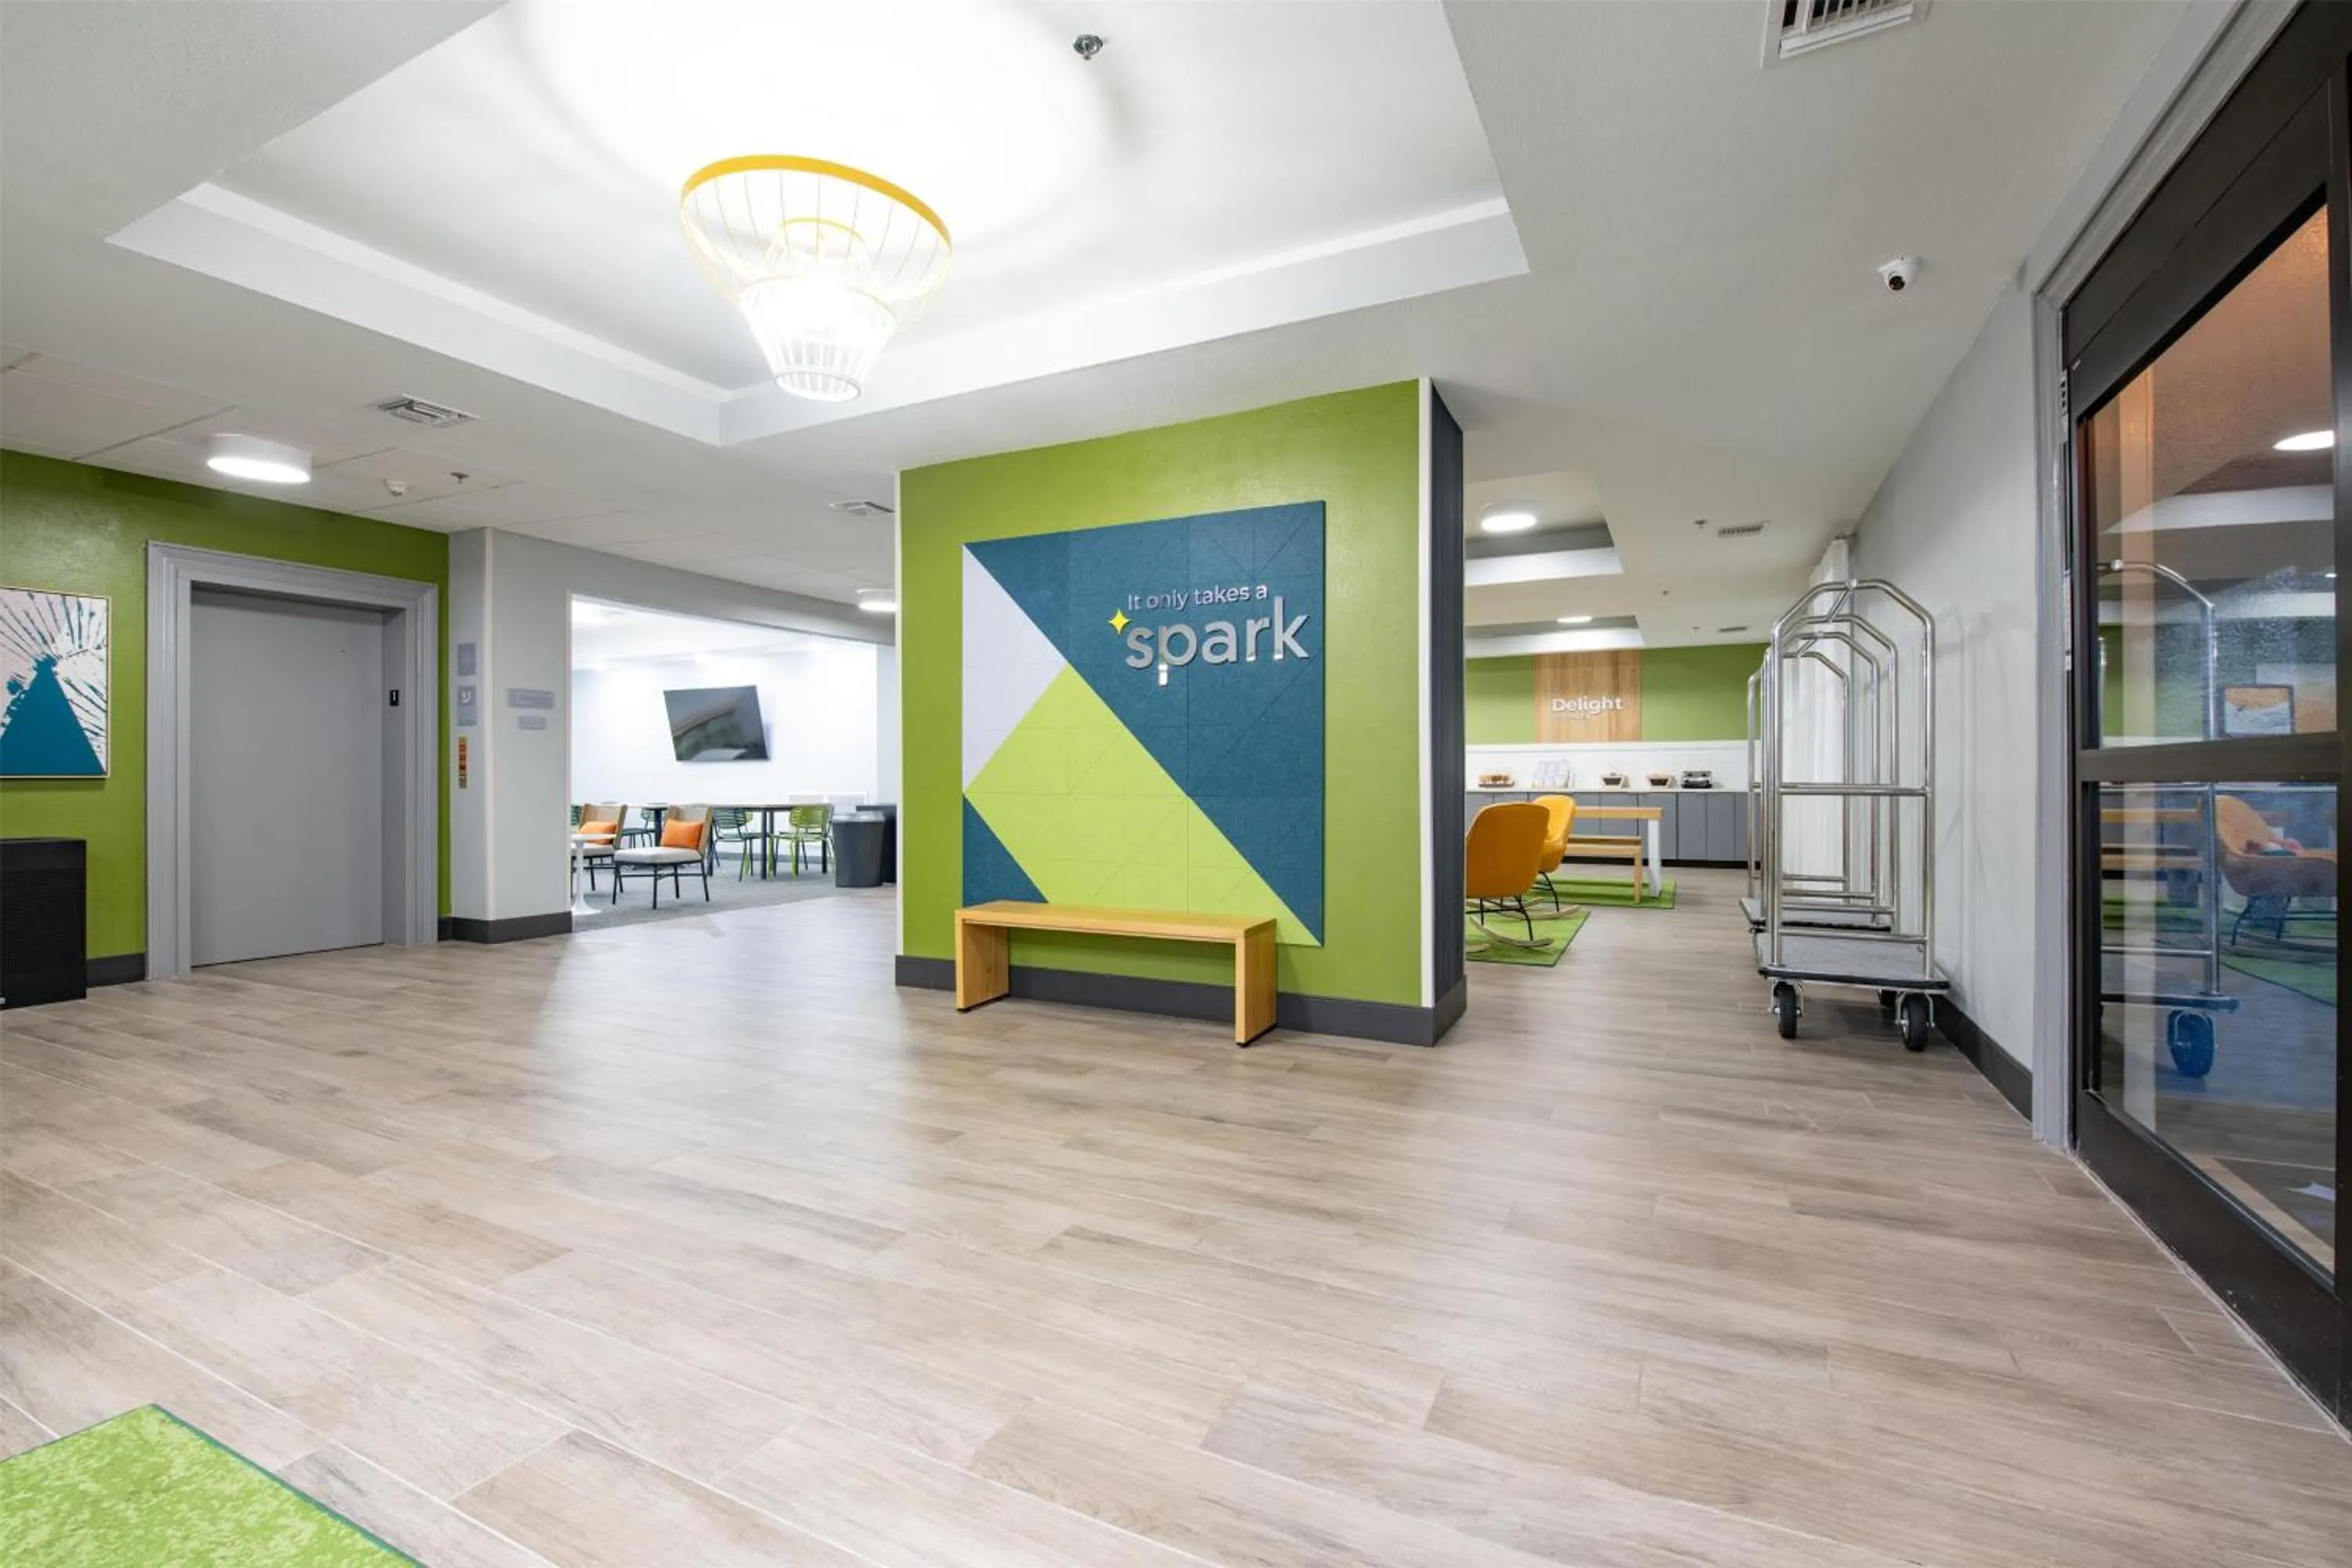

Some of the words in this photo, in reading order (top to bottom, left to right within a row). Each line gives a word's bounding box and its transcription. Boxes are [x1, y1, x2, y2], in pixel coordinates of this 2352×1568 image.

[1127, 594, 1142, 611] It
[1146, 590, 1189, 611] only
[1193, 584, 1249, 604] takes
[1255, 584, 1268, 599] a
[1126, 596, 1310, 686] spark
[1552, 695, 1624, 713] Delight
